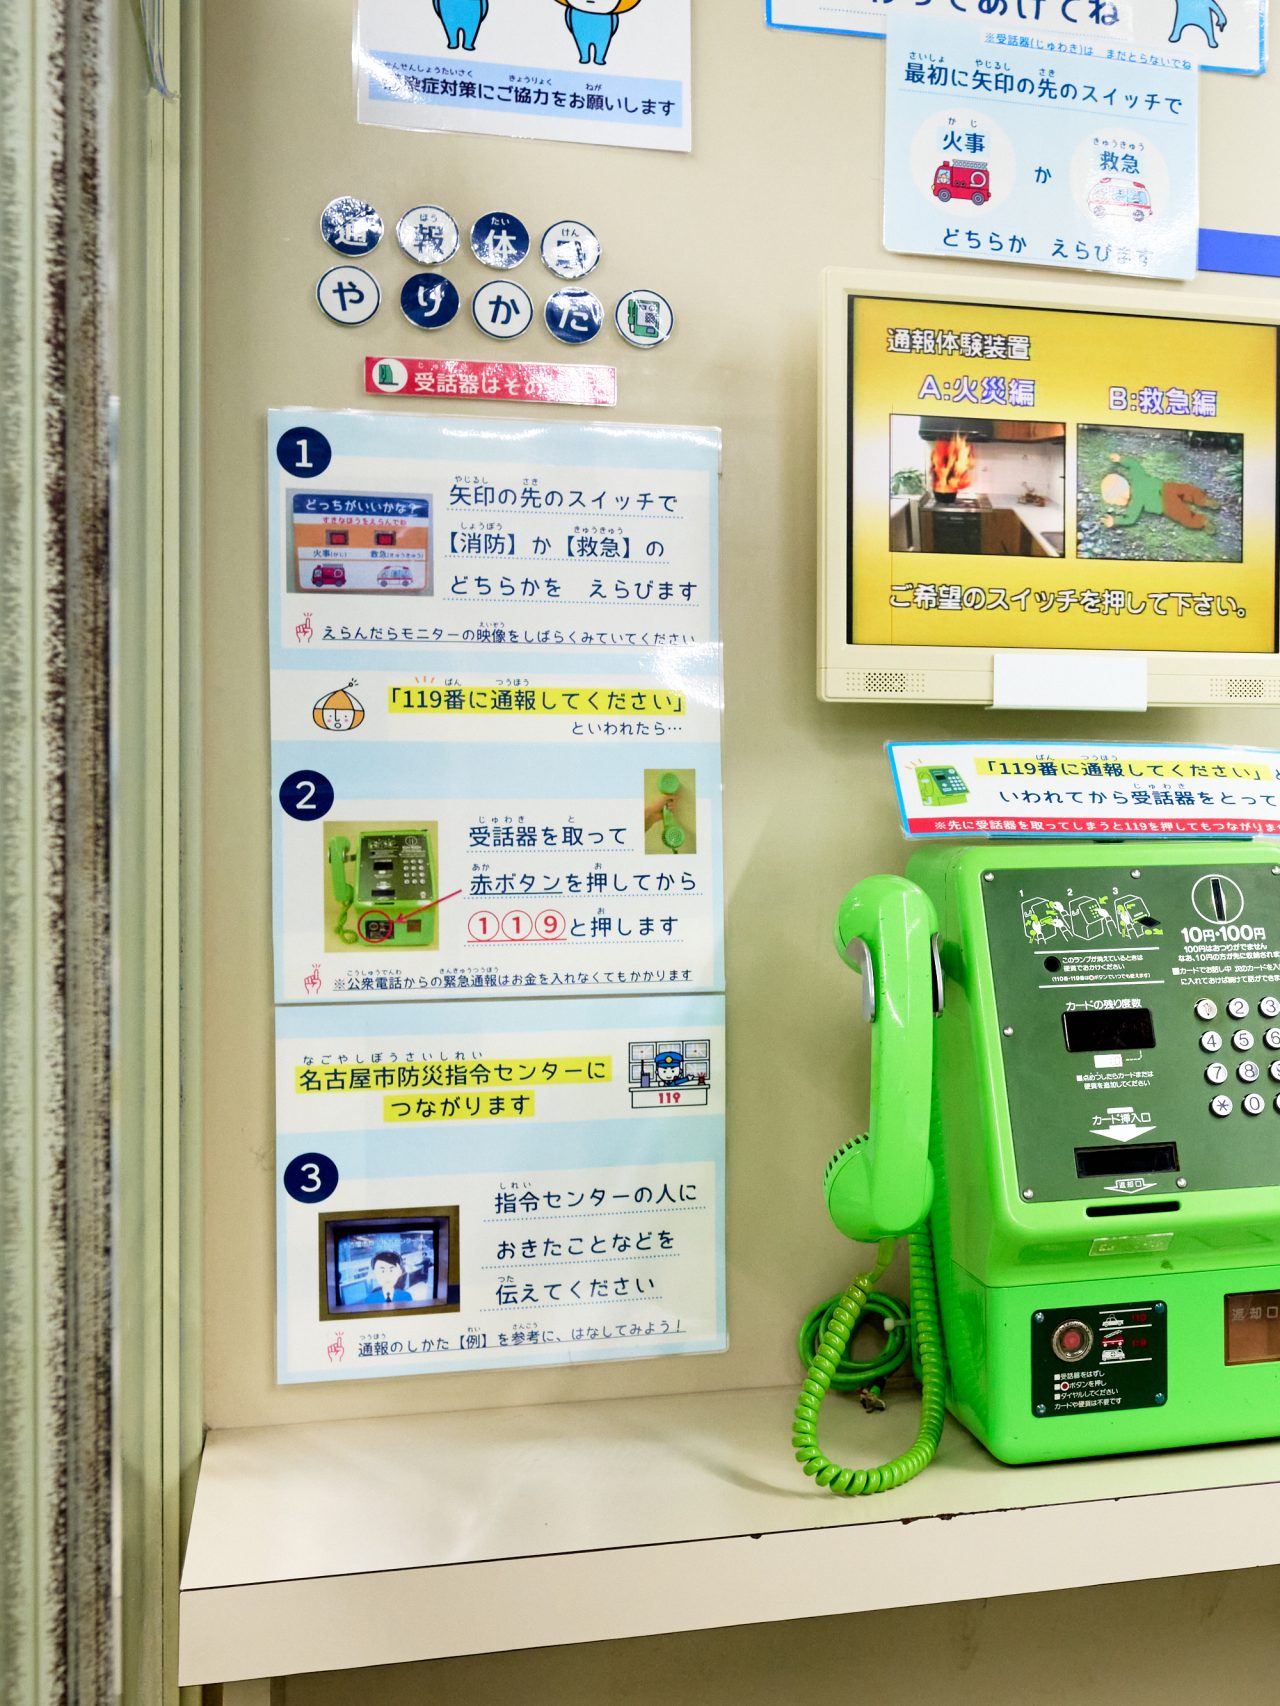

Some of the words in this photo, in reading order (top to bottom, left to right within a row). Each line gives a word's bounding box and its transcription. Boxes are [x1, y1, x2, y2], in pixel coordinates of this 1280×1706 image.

[909, 51, 945, 63] さいしょ
[975, 58, 1011, 72] やじるし
[1107, 49, 1192, 70] まだとらないでね
[508, 74, 552, 86] きょうりょく
[1039, 68, 1056, 78] さき
[585, 83, 602, 91] ねが
[905, 62, 1183, 114] 最初に矢印の先のスイッチで
[385, 74, 676, 117] 染症対策にご協力をお願いします
[942, 130, 986, 154] 火事
[1093, 137, 1145, 152] きゅうきゅう
[1100, 151, 1140, 175] 救急
[1034, 166, 1052, 184] か
[491, 216, 510, 225] たい
[562, 228, 579, 238] けん
[484, 229, 517, 257] 体
[942, 227, 1027, 254] どちらか
[1051, 239, 1154, 268] えらびます
[332, 281, 364, 311] や
[417, 285, 442, 316] り
[489, 295, 520, 324] か
[887, 328, 1031, 361] 通報体験装置
[918, 375, 1036, 407] A:火災編
[1108, 387, 1218, 417] B:救急編
[295, 439, 313, 468] 1
[455, 476, 488, 484] やじるし
[522, 477, 538, 486] さき
[306, 499, 419, 514] どっちがいいかな？
[449, 484, 678, 513] 矢印の先のスイッチで
[460, 521, 503, 531] しょうぼう
[574, 526, 624, 534] きゅうきゅう
[451, 576, 561, 598] どちらかを
[589, 579, 698, 600] えらびます
[889, 583, 1247, 618] ご希望のスイッチを押して下さい。
[322, 626, 696, 645] えらんだらモニターの映像をしばらくみていてください
[445, 678, 461, 686] ばん
[495, 678, 529, 686] つうほう
[391, 687, 683, 711] 「119番に通報してください」
[294, 780, 317, 810] 2
[478, 816, 525, 824] じゅわき
[469, 826, 627, 847] 受話器を取って
[472, 863, 489, 872] あか
[470, 871, 697, 894] 赤ボタンを押してから
[1181, 925, 1266, 943] 10円・100円
[439, 966, 499, 974] きんきゅうつうほう
[334, 969, 693, 990] ※公衆電話からの緊急通報はお金を入れなくてもかかります
[1066, 998, 1142, 1011] カードの残り度数
[1234, 1001, 1244, 1014] 2
[1266, 1000, 1277, 1013] 3
[1207, 1034, 1216, 1047] 4
[1239, 1033, 1249, 1046] 5
[1271, 1031, 1280, 1044] 6
[303, 1049, 484, 1065] なごやしぼうさいしれい
[300, 1062, 606, 1090] 名古屋市防災指令センターに
[1213, 1066, 1222, 1079] 7
[1244, 1064, 1255, 1077] 8
[391, 1094, 530, 1118] つながります
[659, 1092, 681, 1104] 119
[1249, 1096, 1260, 1110] 0
[1092, 1113, 1151, 1126] カード挿入口
[300, 1163, 321, 1192] 3
[500, 1181, 531, 1189] しれい
[494, 1182, 697, 1213] 指令センターの人に
[497, 1230, 675, 1259] おきたことなどを
[498, 1275, 514, 1283] つた
[496, 1277, 655, 1305] 伝えてください
[1231, 1306, 1279, 1321] 返却口
[1060, 1388, 1118, 1399] ダイヤルしてください
